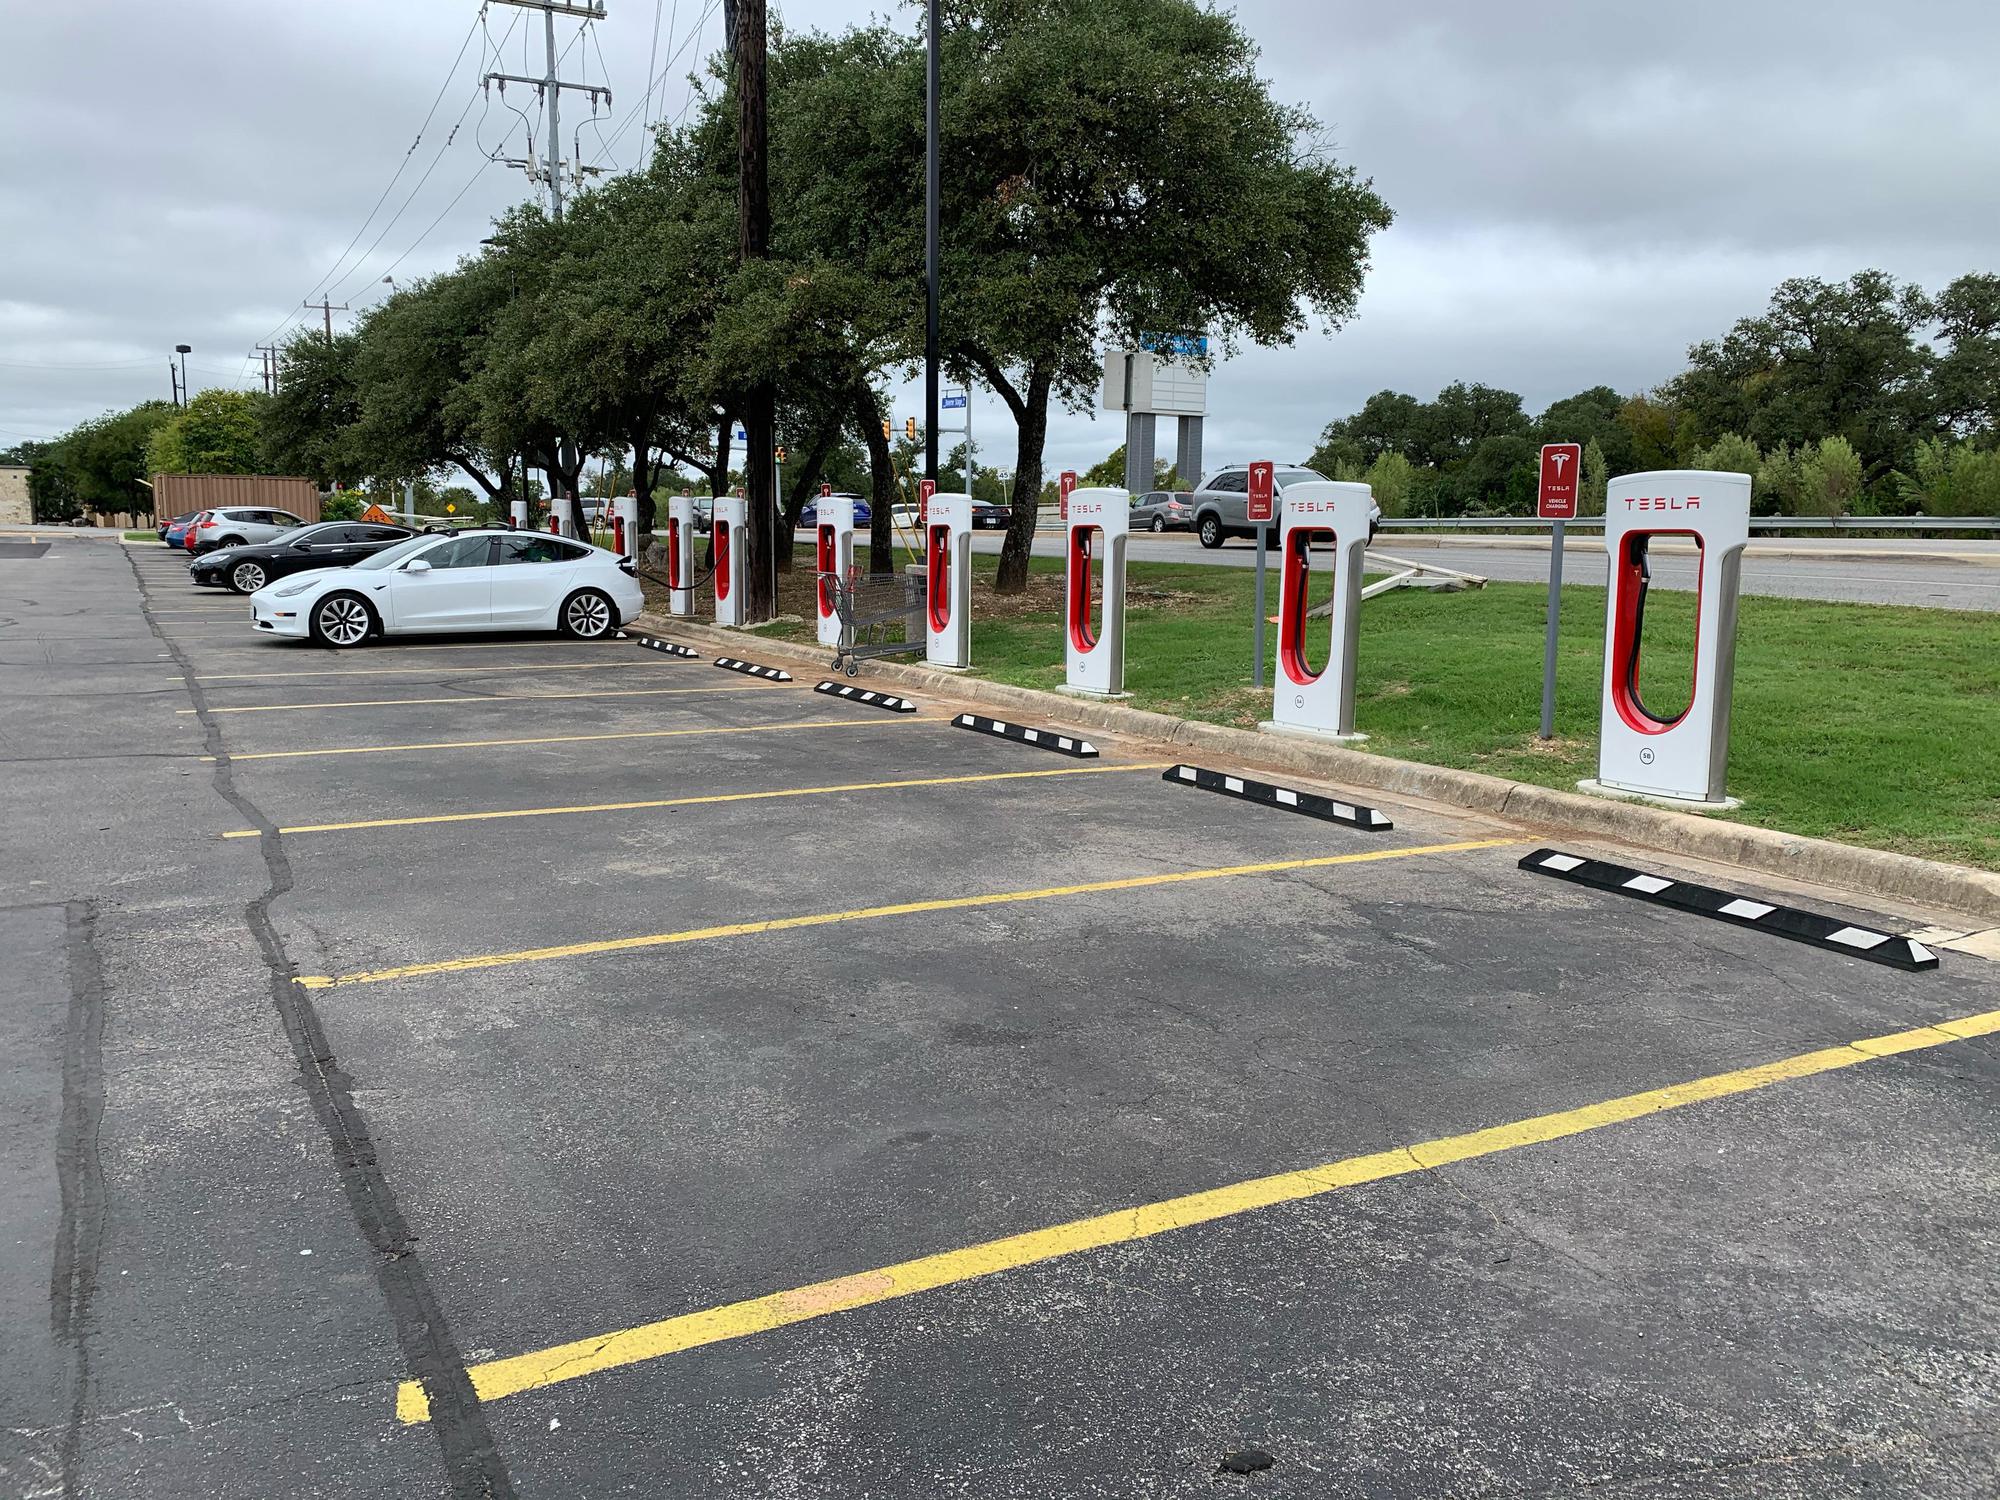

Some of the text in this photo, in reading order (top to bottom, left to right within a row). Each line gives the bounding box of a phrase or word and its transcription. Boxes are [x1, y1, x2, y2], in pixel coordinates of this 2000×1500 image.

[1072, 504, 1102, 514] TESLA
[1290, 502, 1335, 512] TESLA
[1625, 497, 1700, 511] TESLA
